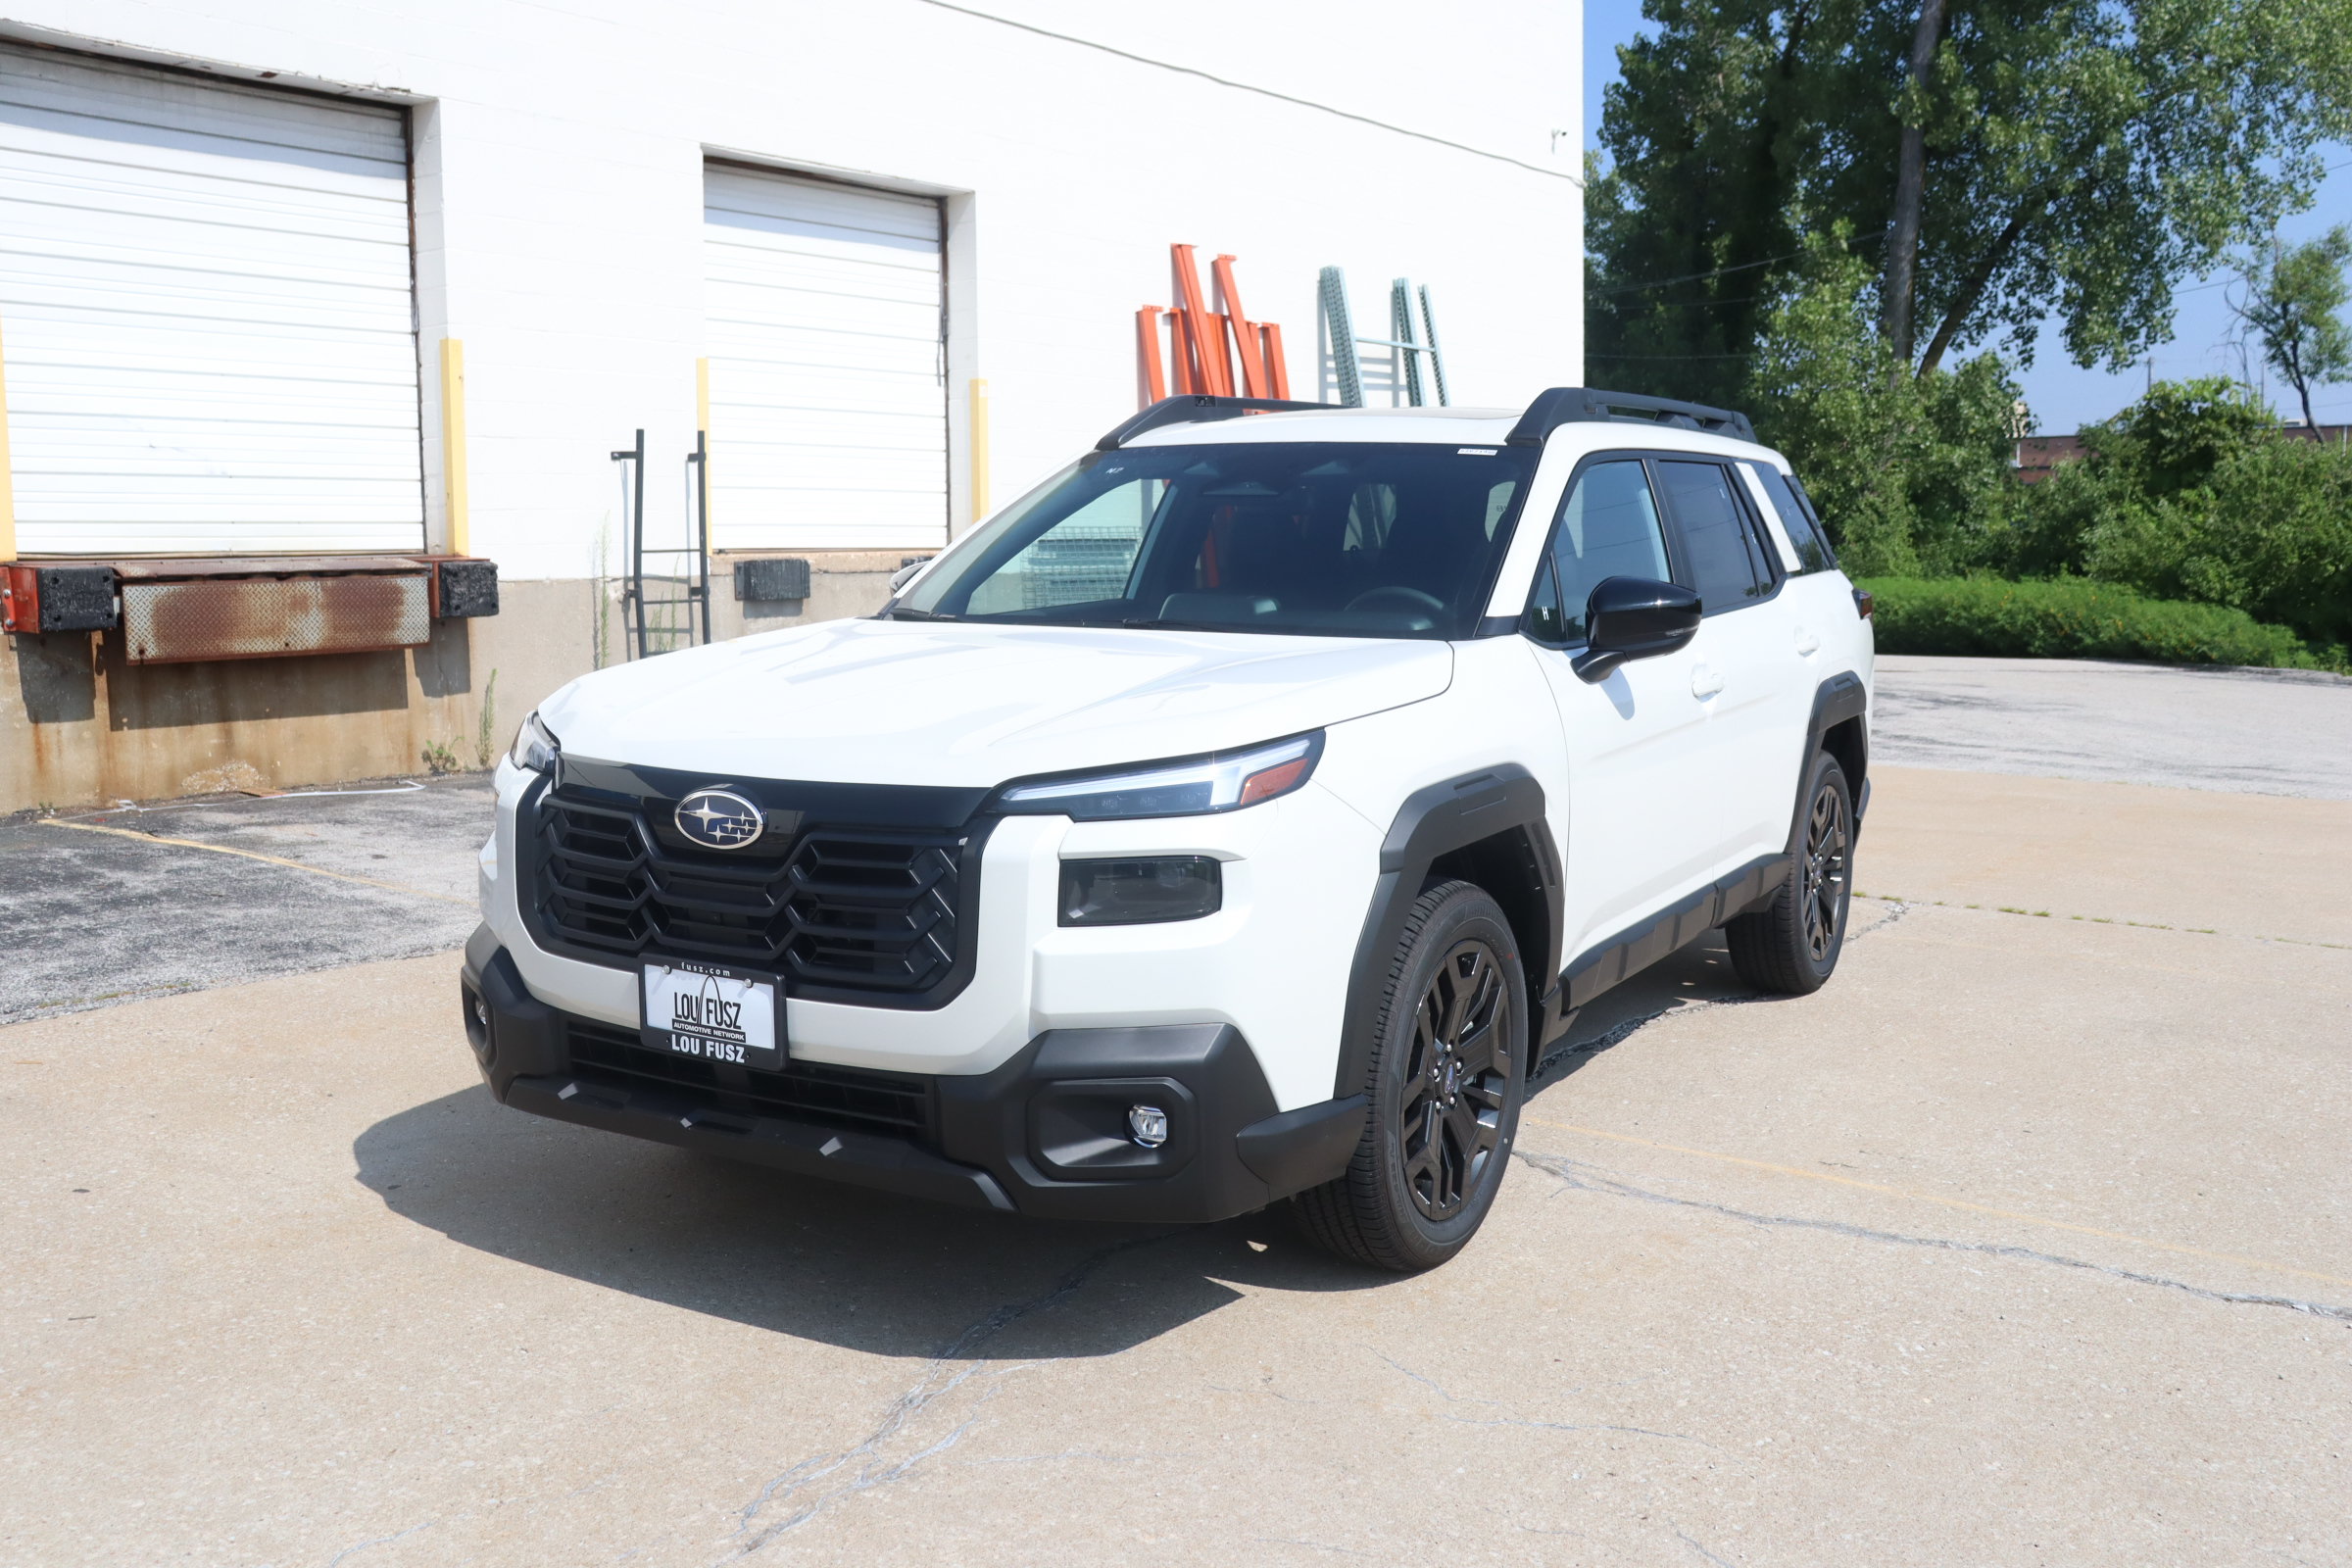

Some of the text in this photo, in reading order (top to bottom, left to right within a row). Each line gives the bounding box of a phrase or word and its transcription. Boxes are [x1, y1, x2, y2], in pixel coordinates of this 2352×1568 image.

[681, 961, 731, 977] fusz.com
[674, 992, 742, 1030] LOU FUSZ
[673, 1021, 745, 1041] AUTOMOTIVE NETWORK
[671, 1034, 745, 1063] LOU FUSZ
